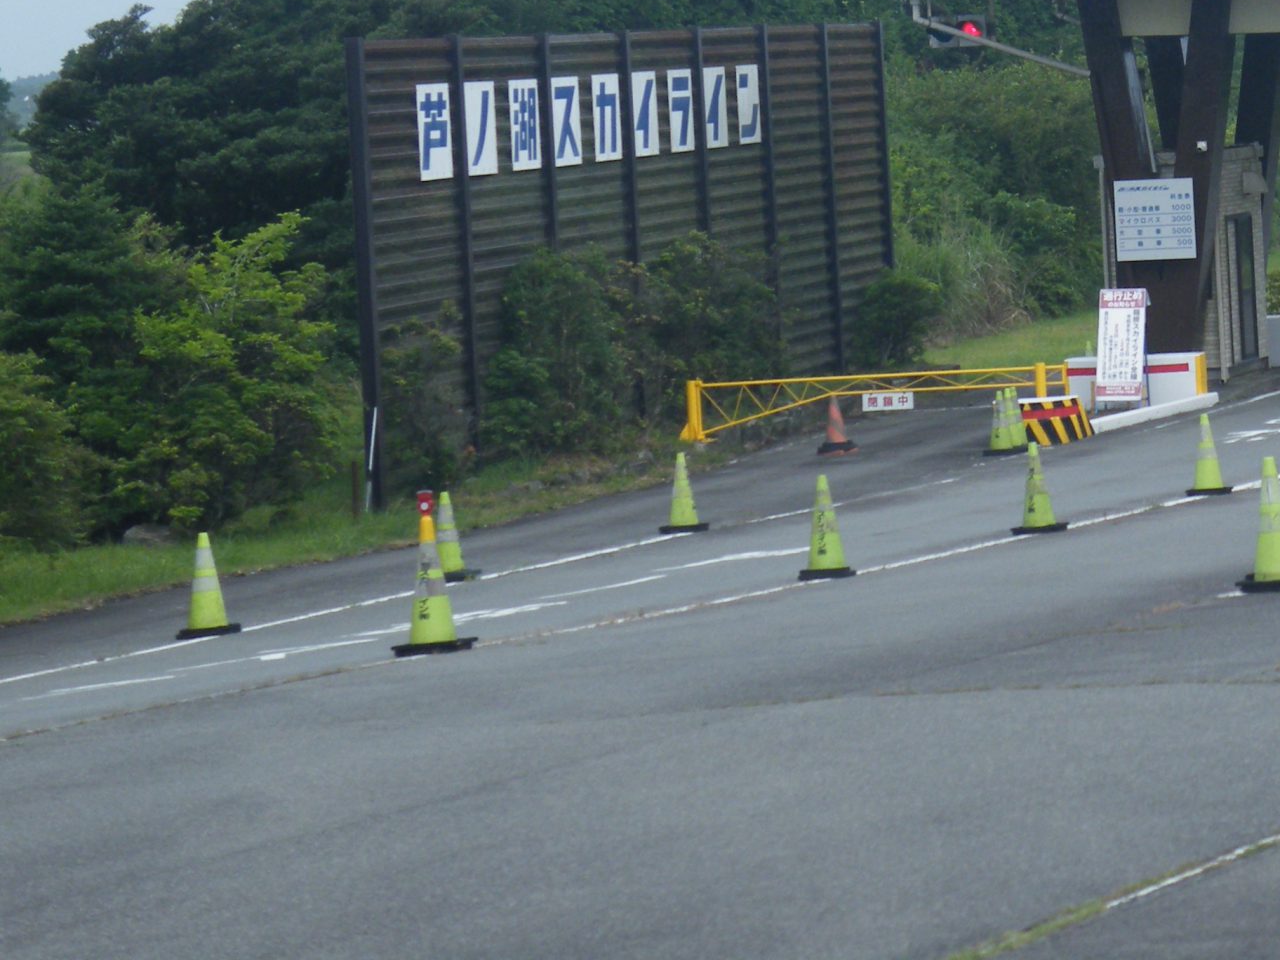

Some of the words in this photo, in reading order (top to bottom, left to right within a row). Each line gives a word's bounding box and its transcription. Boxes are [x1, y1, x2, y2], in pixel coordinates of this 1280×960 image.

[419, 73, 760, 171] 芦ノ湖スカイライン
[1171, 203, 1191, 211] 1000
[1119, 216, 1161, 224] マイクロバス
[1177, 238, 1193, 246] 500
